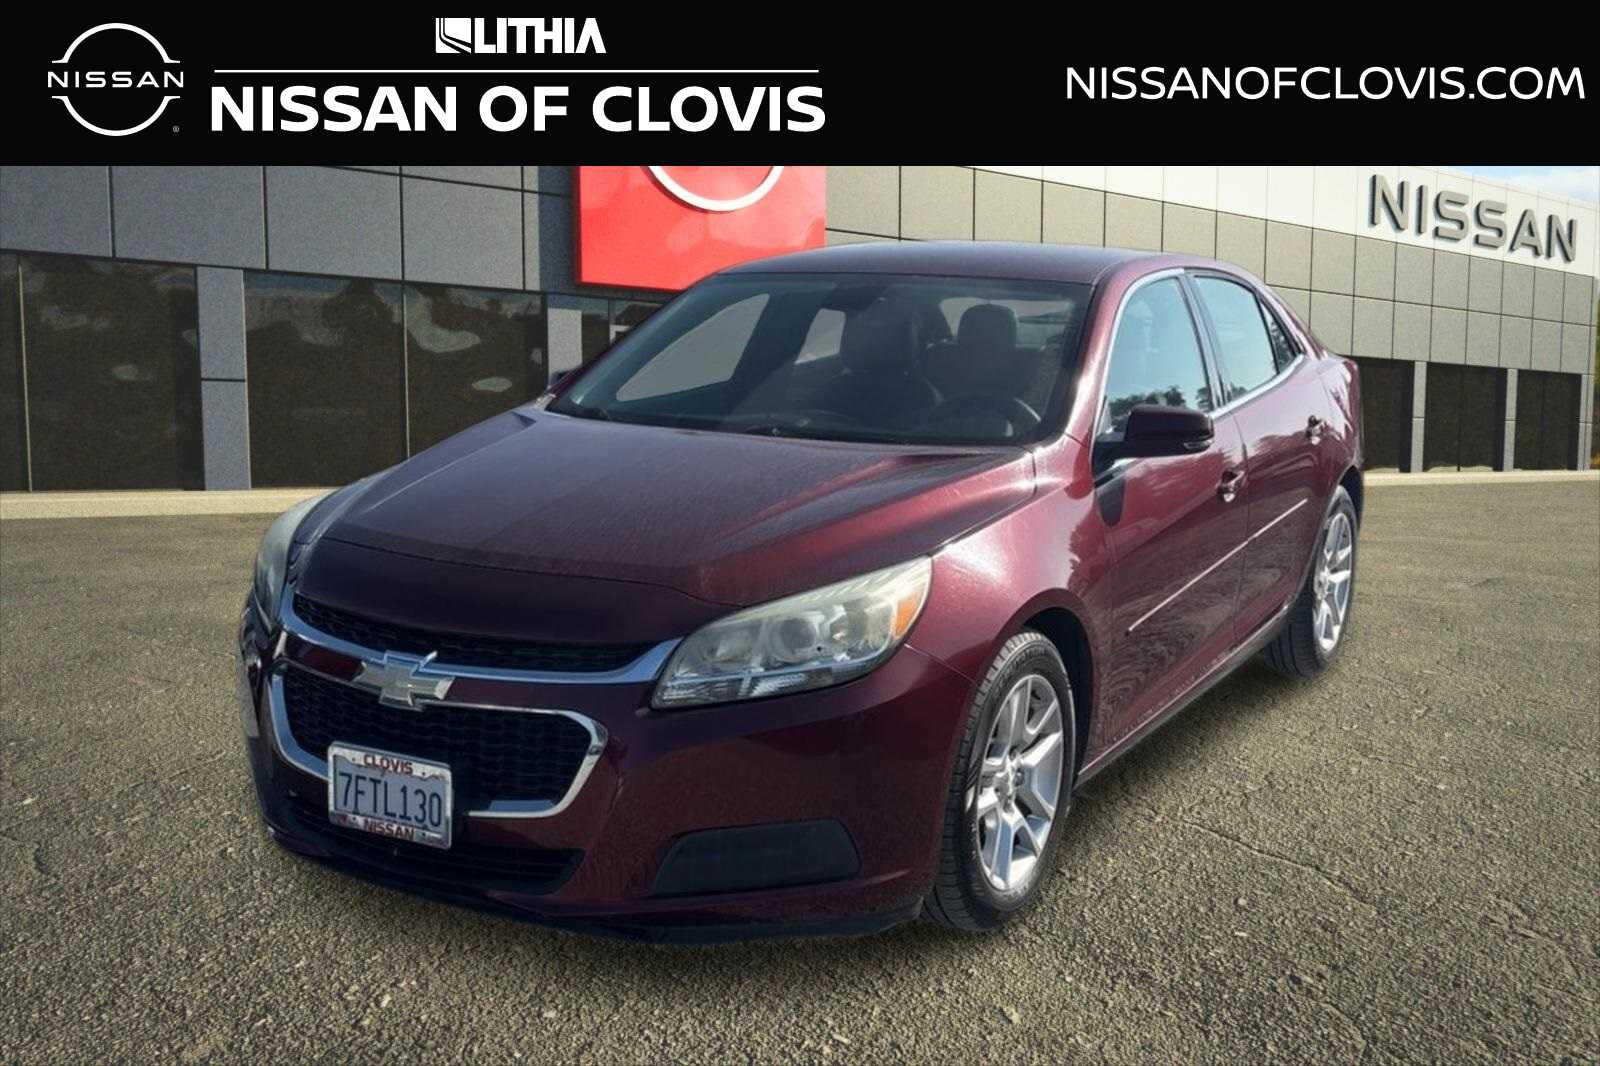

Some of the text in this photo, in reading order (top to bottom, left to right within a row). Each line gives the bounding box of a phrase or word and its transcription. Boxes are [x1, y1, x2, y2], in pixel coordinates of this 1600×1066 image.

[1370, 174, 1578, 262] NISSAN
[363, 754, 414, 775] CLOVIS
[338, 772, 442, 828] 7FTL130
[363, 818, 415, 841] NISSAN
